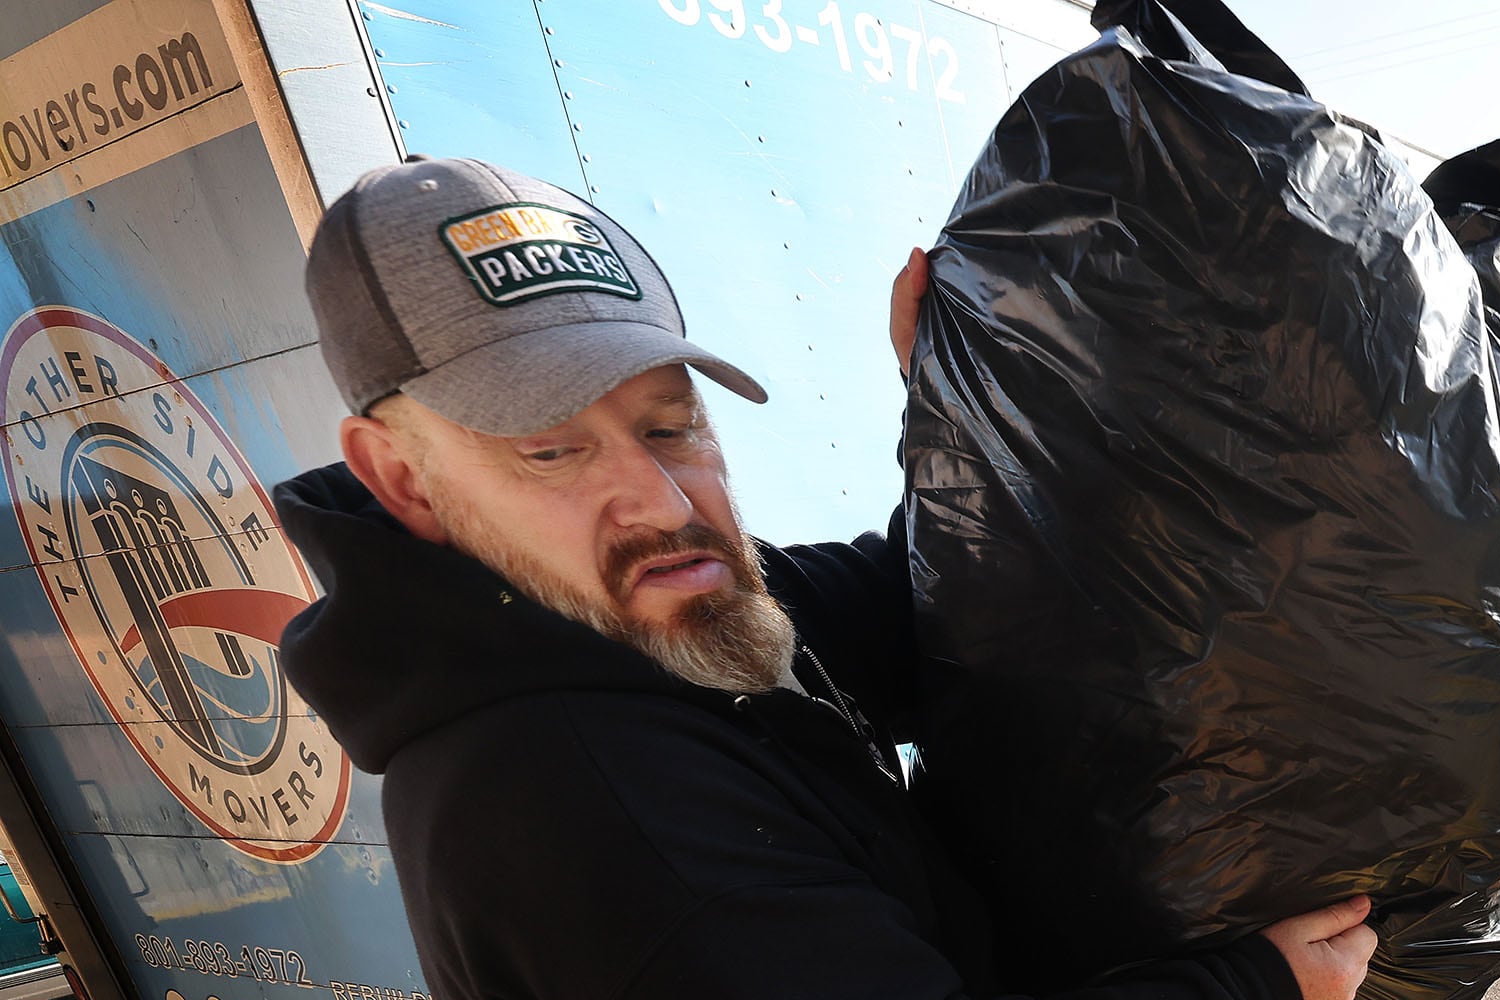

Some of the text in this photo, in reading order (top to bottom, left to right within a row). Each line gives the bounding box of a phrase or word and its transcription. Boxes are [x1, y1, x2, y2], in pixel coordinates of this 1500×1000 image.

[449, 212, 523, 252] GREEN
[478, 243, 629, 288] PACKERS
[19, 350, 271, 605] THE OTHER SIDE
[187, 741, 324, 831] MOVERS
[134, 932, 314, 989] 801-893-1972
